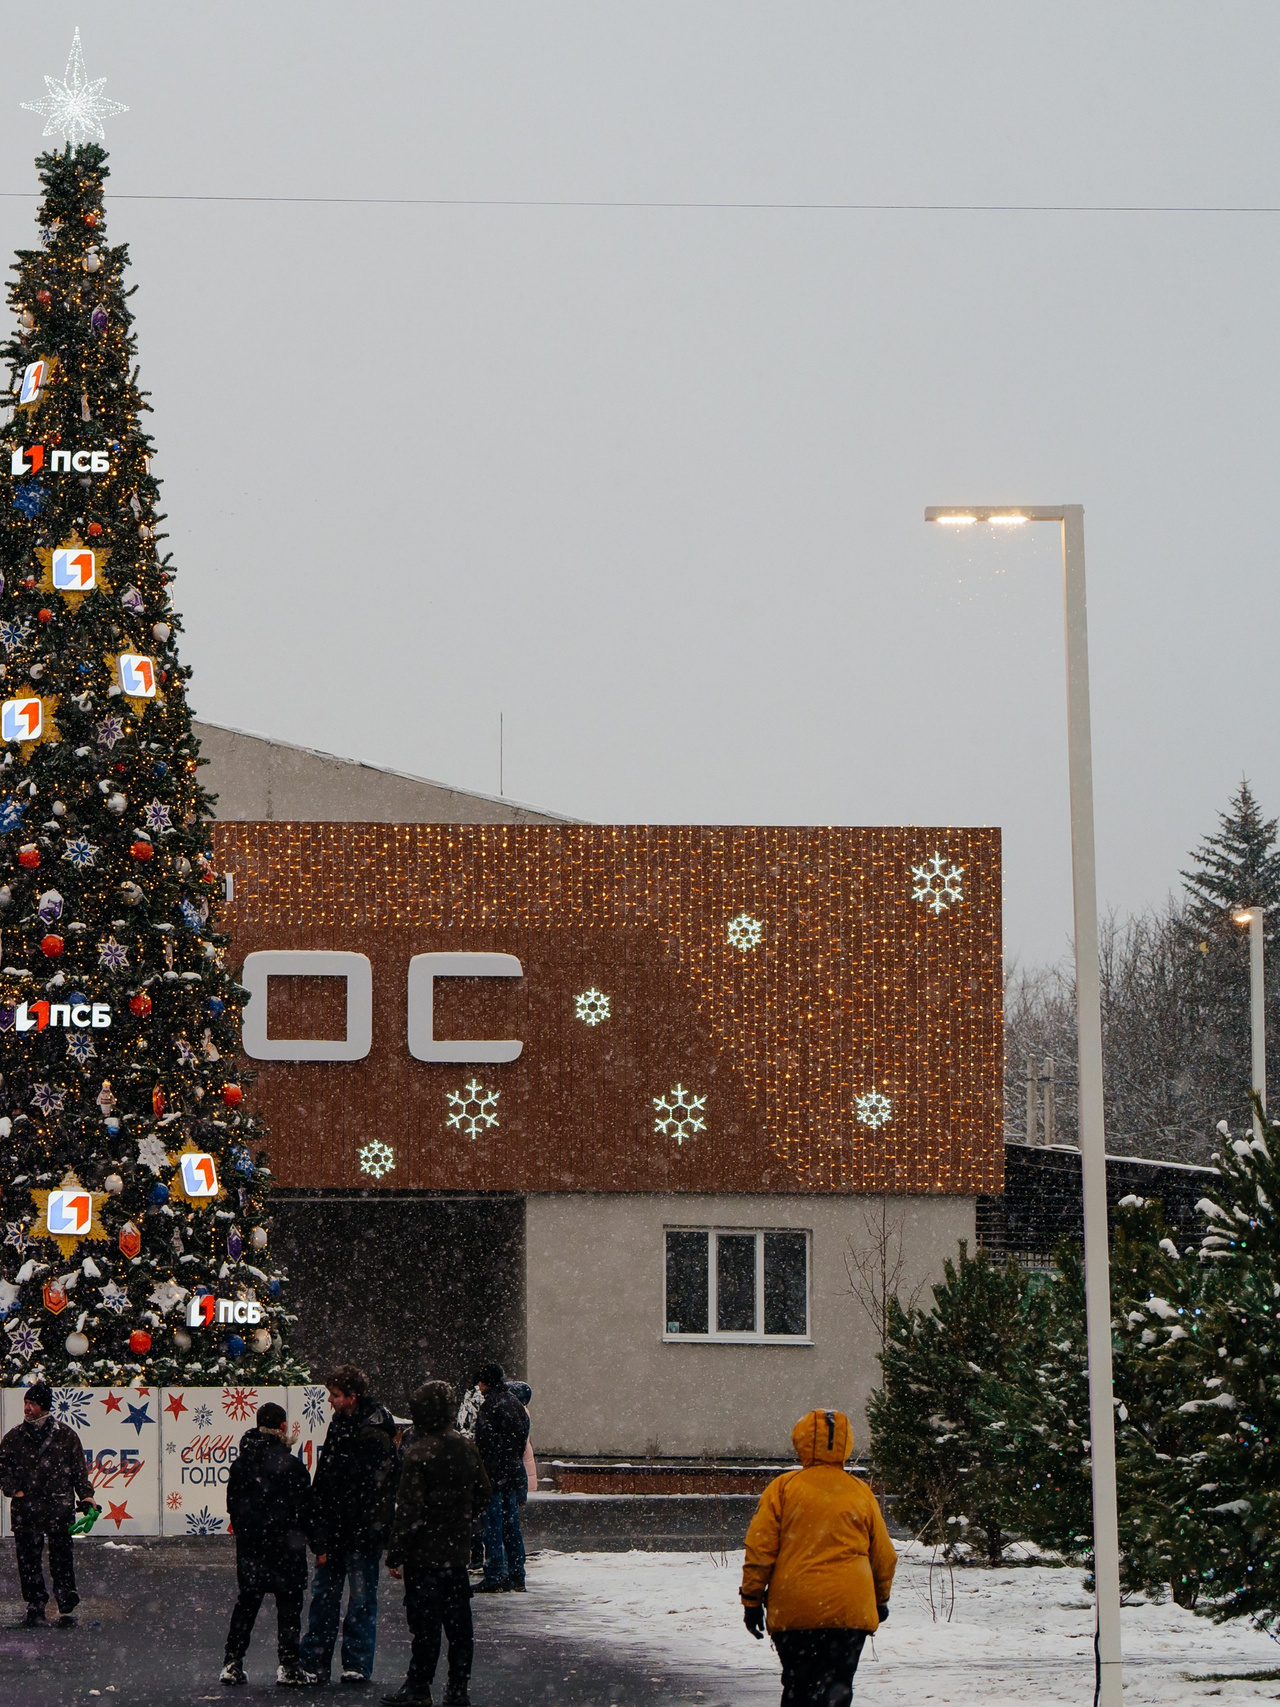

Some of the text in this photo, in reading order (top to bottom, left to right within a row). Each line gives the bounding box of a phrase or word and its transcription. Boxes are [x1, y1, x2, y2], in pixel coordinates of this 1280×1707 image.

[50, 450, 110, 472] ПСБ
[50, 1003, 112, 1028] ПСБ
[217, 1299, 261, 1324] ПСБ
[200, 1446, 239, 1464] НОВ
[181, 1466, 231, 1487] ГОДО
